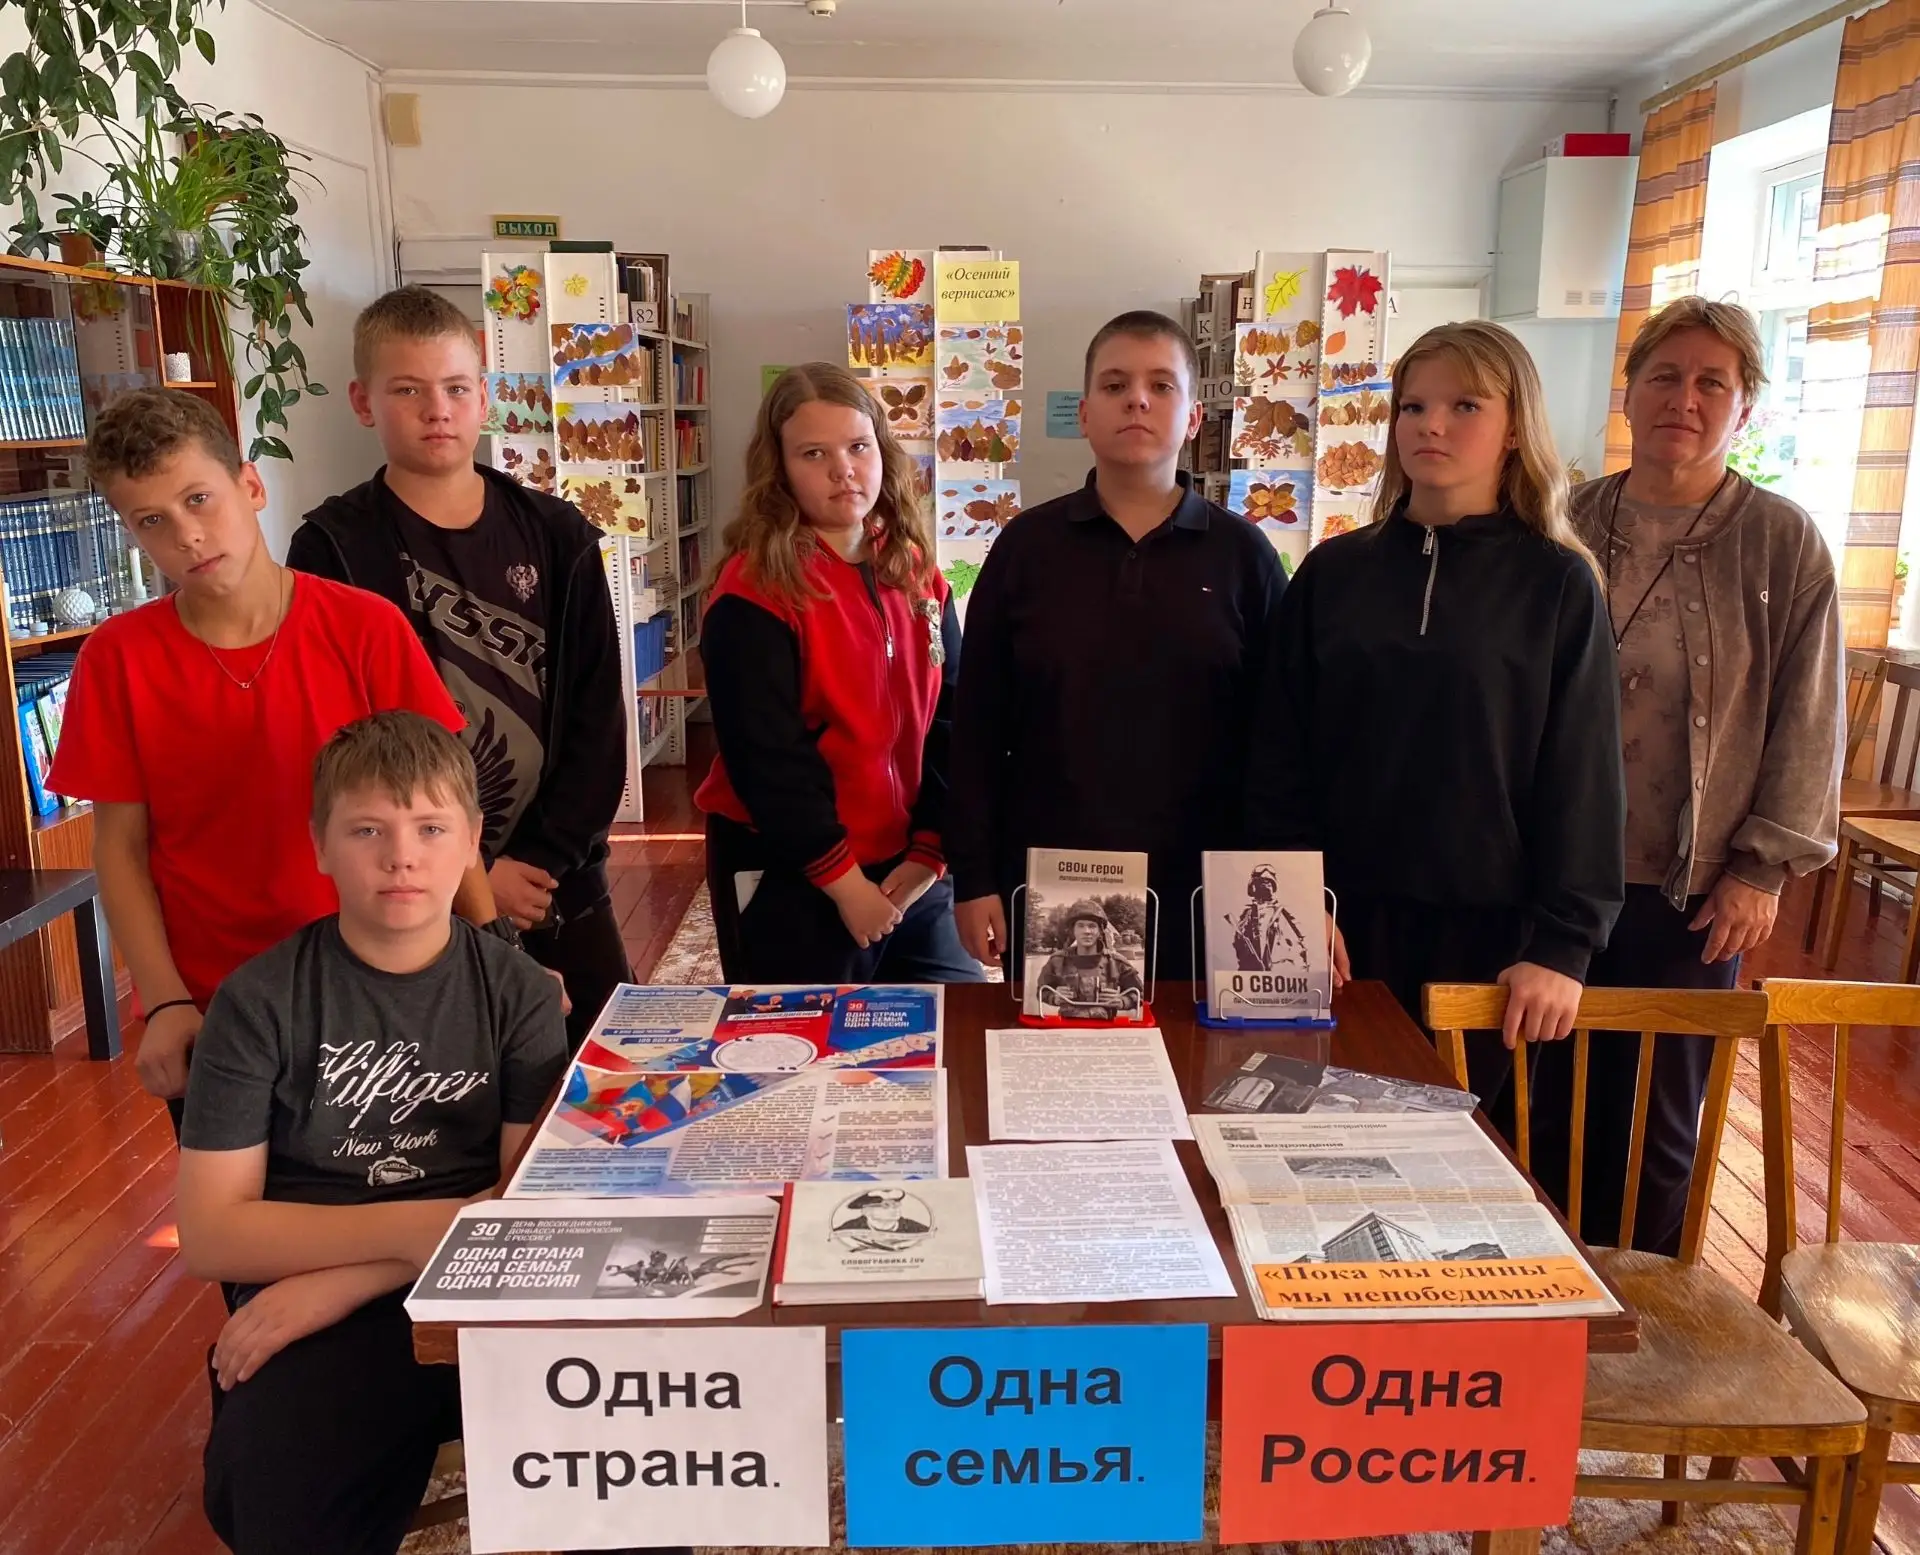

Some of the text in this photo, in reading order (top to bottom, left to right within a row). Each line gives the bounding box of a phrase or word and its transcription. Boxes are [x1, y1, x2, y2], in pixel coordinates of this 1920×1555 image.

[498, 222, 555, 235] ВЫХОД
[946, 267, 1011, 280] «Осенний
[941, 289, 1015, 302] вернисаж»
[636, 308, 654, 324] 82
[1090, 864, 1124, 875] герои
[317, 1040, 489, 1129] Hilfiger
[332, 1128, 439, 1158] New York
[471, 1223, 502, 1236] 30
[453, 1246, 585, 1262] ОДНА СТРАНА
[445, 1260, 573, 1275] ОДНА СЕМЬЯ
[1263, 1266, 1369, 1281] «Пока
[1379, 1267, 1432, 1279] мы
[1441, 1263, 1548, 1281] едины
[436, 1274, 581, 1290] ОДНА РОССИЯ!
[1278, 1283, 1585, 1303] мы непобедимы!»
[547, 1356, 741, 1416] Одна
[930, 1356, 1121, 1413] Одна
[1312, 1355, 1502, 1415] Одна
[906, 1447, 1147, 1486] семья.
[1262, 1435, 1537, 1484] Россия.
[513, 1450, 780, 1500] страна.
